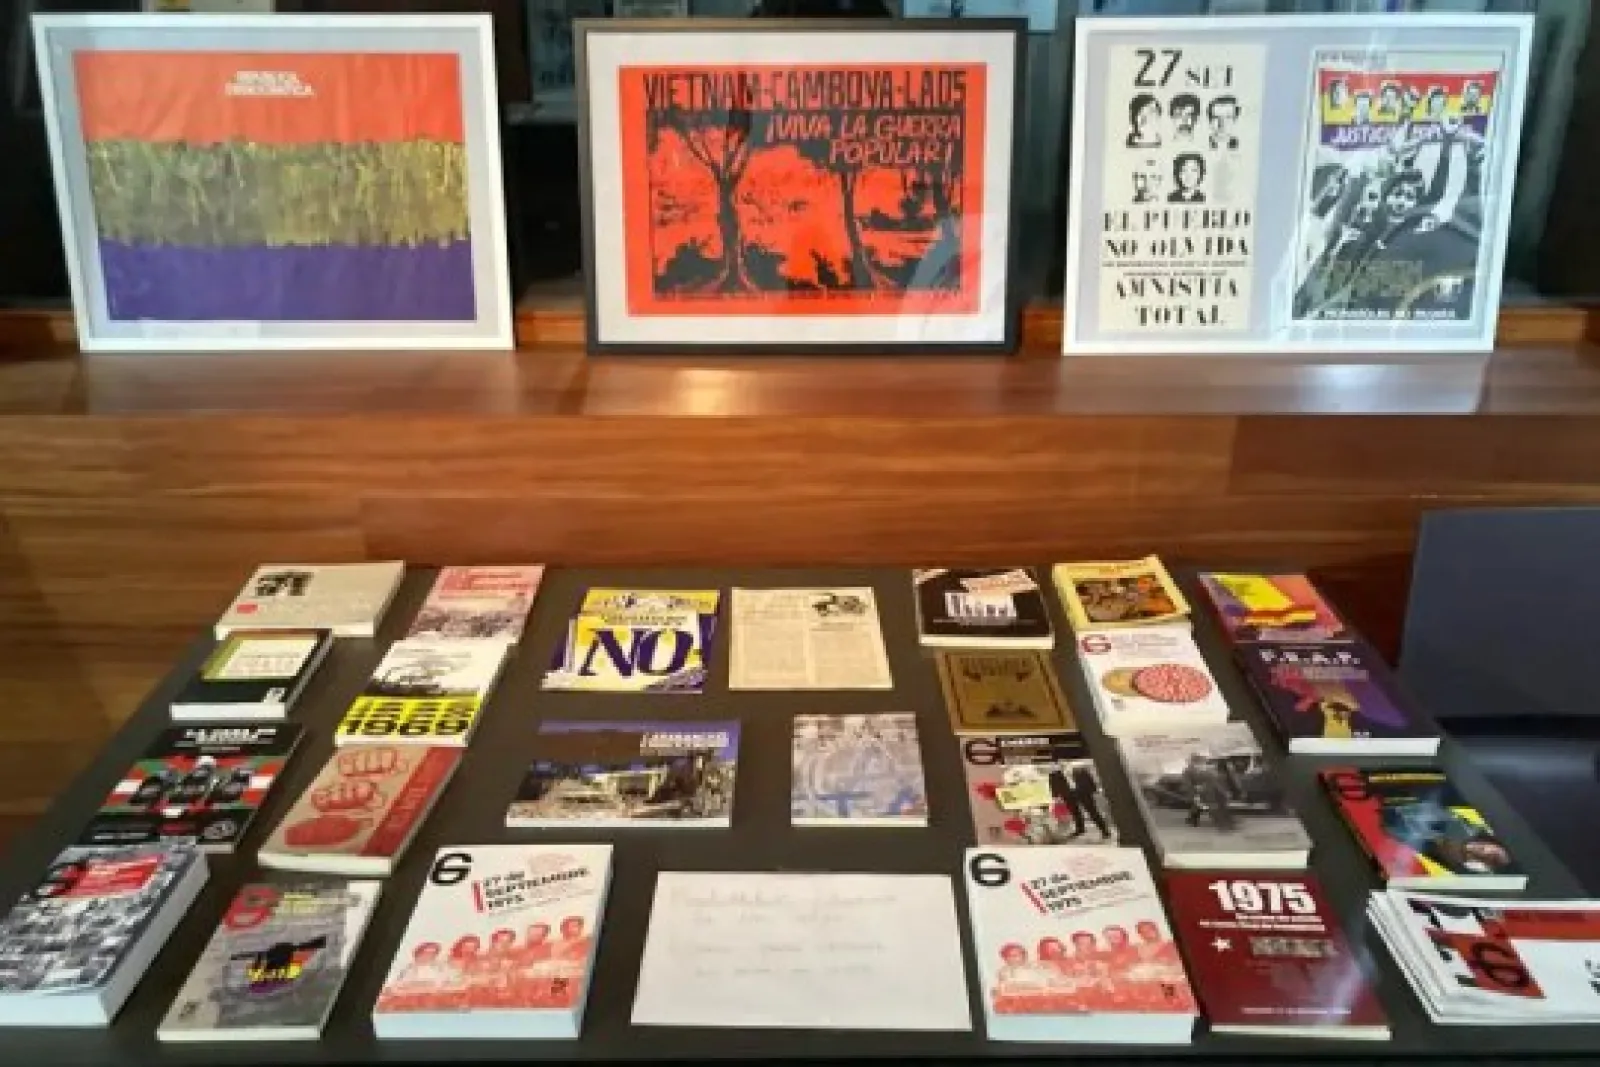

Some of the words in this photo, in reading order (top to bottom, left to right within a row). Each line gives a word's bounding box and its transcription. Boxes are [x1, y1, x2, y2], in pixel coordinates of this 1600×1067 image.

[1134, 48, 1184, 88] 27
[840, 115, 871, 138] LA
[876, 114, 962, 140] GUERRA
[1103, 210, 1137, 232] EL
[1142, 208, 1251, 231] PUEBLO
[1106, 237, 1139, 259] NO
[1148, 235, 1250, 258] OLVIDA
[1134, 304, 1226, 327] TOTAL
[578, 627, 697, 678] NO
[344, 718, 472, 737] 1969
[487, 894, 525, 910] 1975
[1046, 896, 1083, 911] 1975
[1209, 879, 1317, 914] 1975
